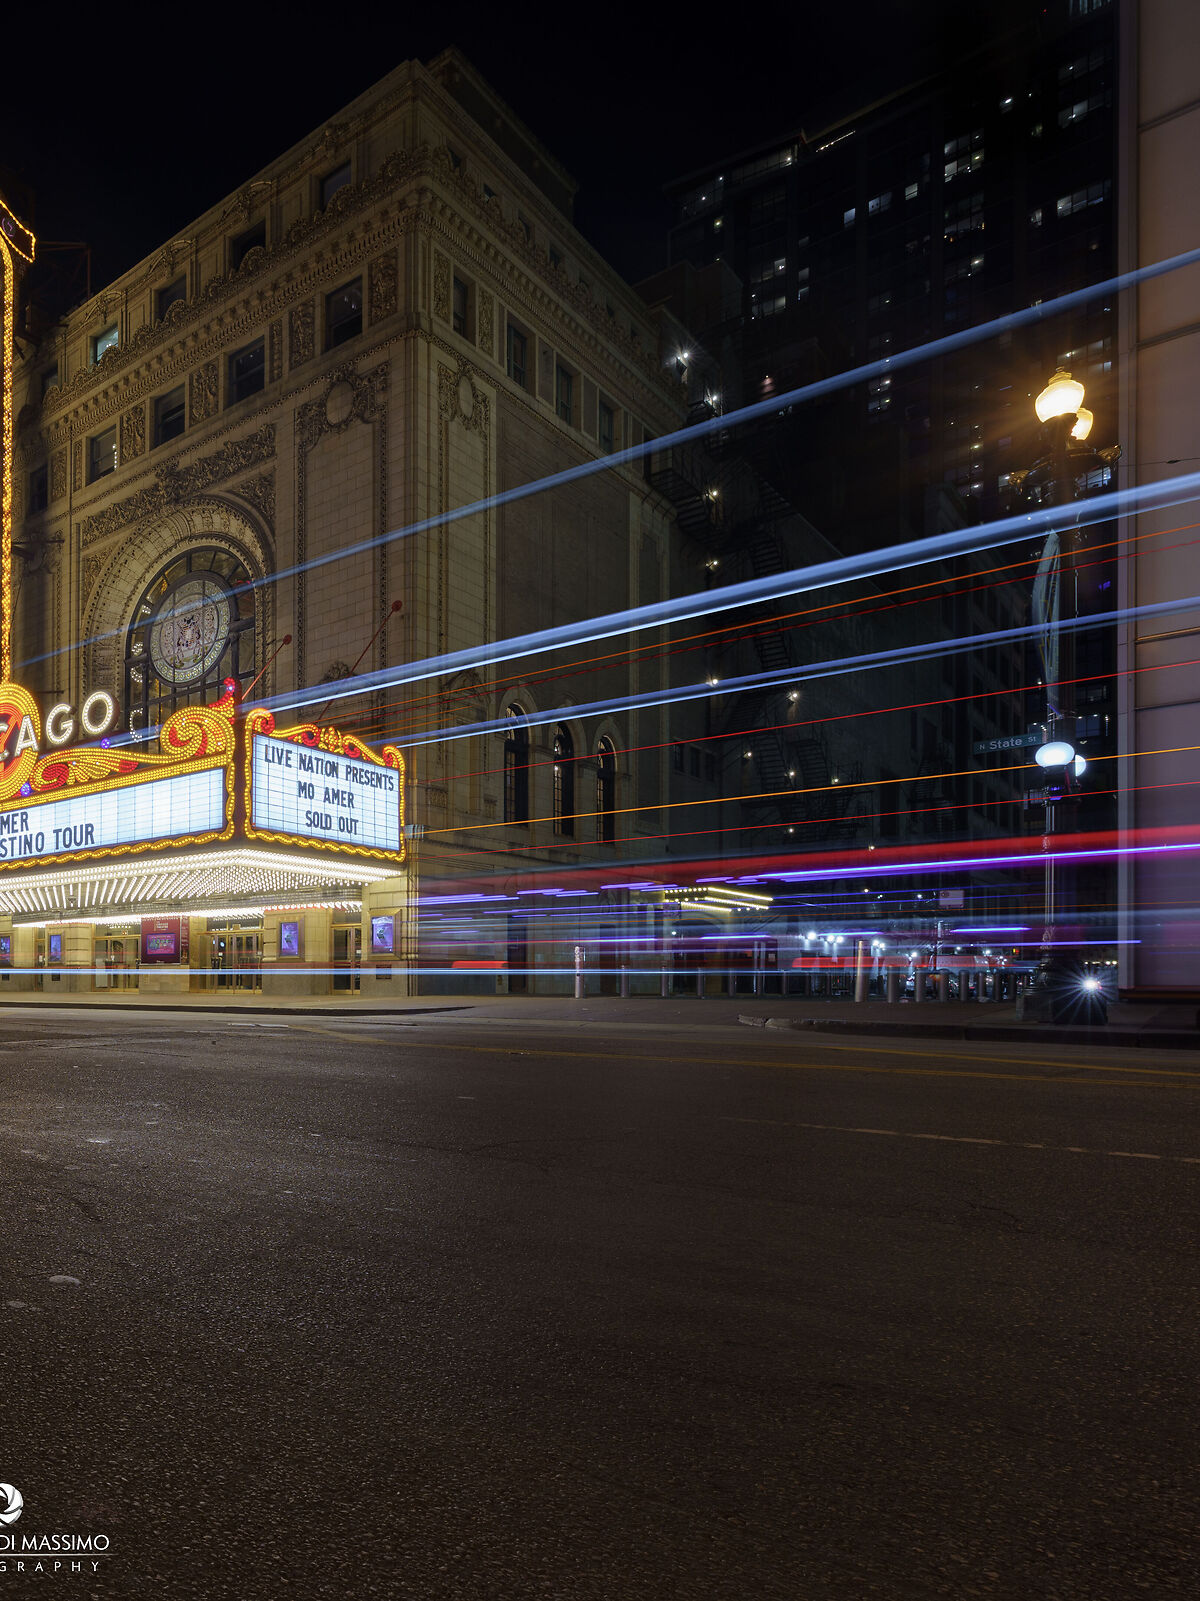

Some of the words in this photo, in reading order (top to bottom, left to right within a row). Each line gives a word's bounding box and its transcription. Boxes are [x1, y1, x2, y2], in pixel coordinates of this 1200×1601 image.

[989, 737, 1022, 750] State
[264, 744, 293, 768] LIVE
[298, 753, 339, 779] NATION
[345, 764, 394, 791] PRESENTS
[298, 781, 315, 800] MO
[323, 787, 355, 809] AMER
[305, 810, 332, 831] SOLD
[338, 816, 359, 835] OUT
[53, 823, 95, 850] TOUR
